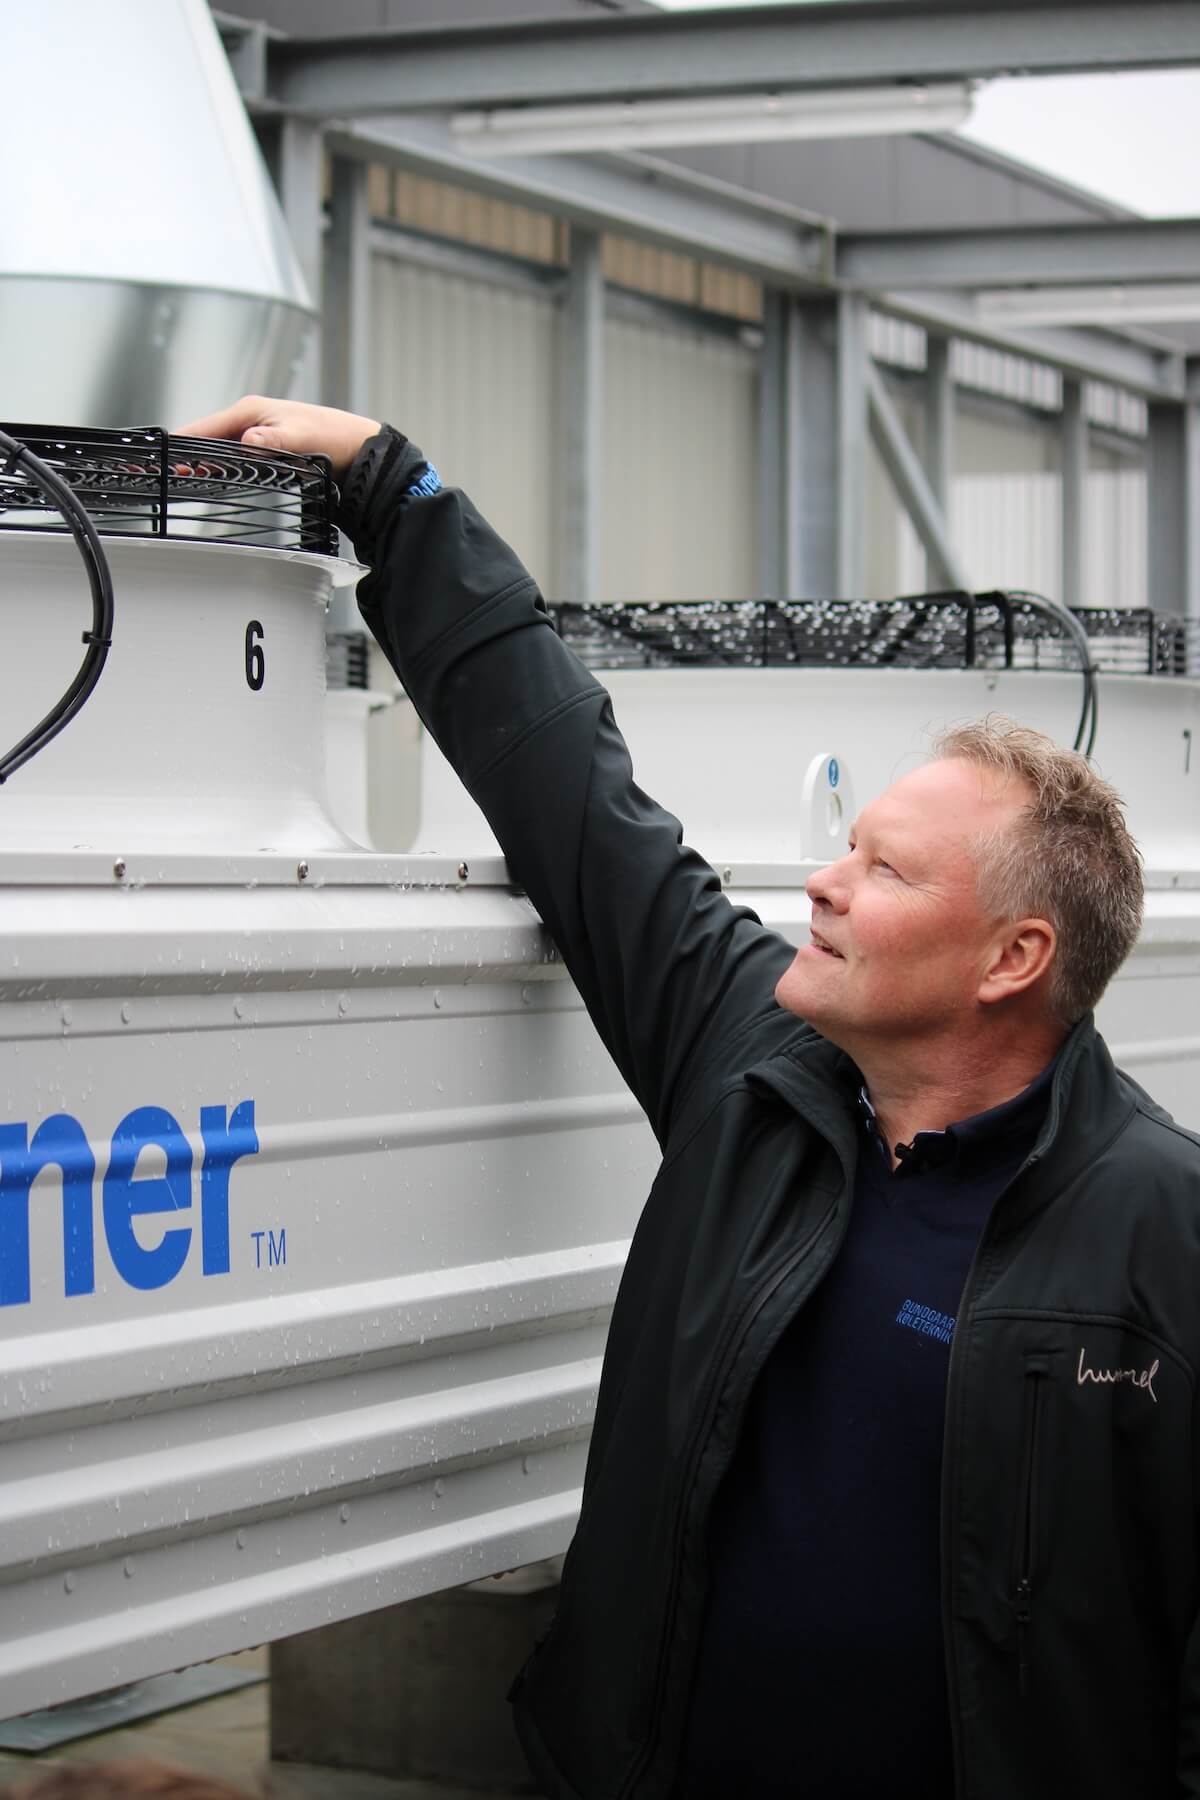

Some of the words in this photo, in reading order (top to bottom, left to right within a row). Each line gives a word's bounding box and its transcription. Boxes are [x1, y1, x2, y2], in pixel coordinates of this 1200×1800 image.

[245, 620, 265, 692] 6
[0, 1099, 259, 1308] ner
[250, 1228, 287, 1269] TM
[902, 1299, 958, 1330] BUNDGAAR
